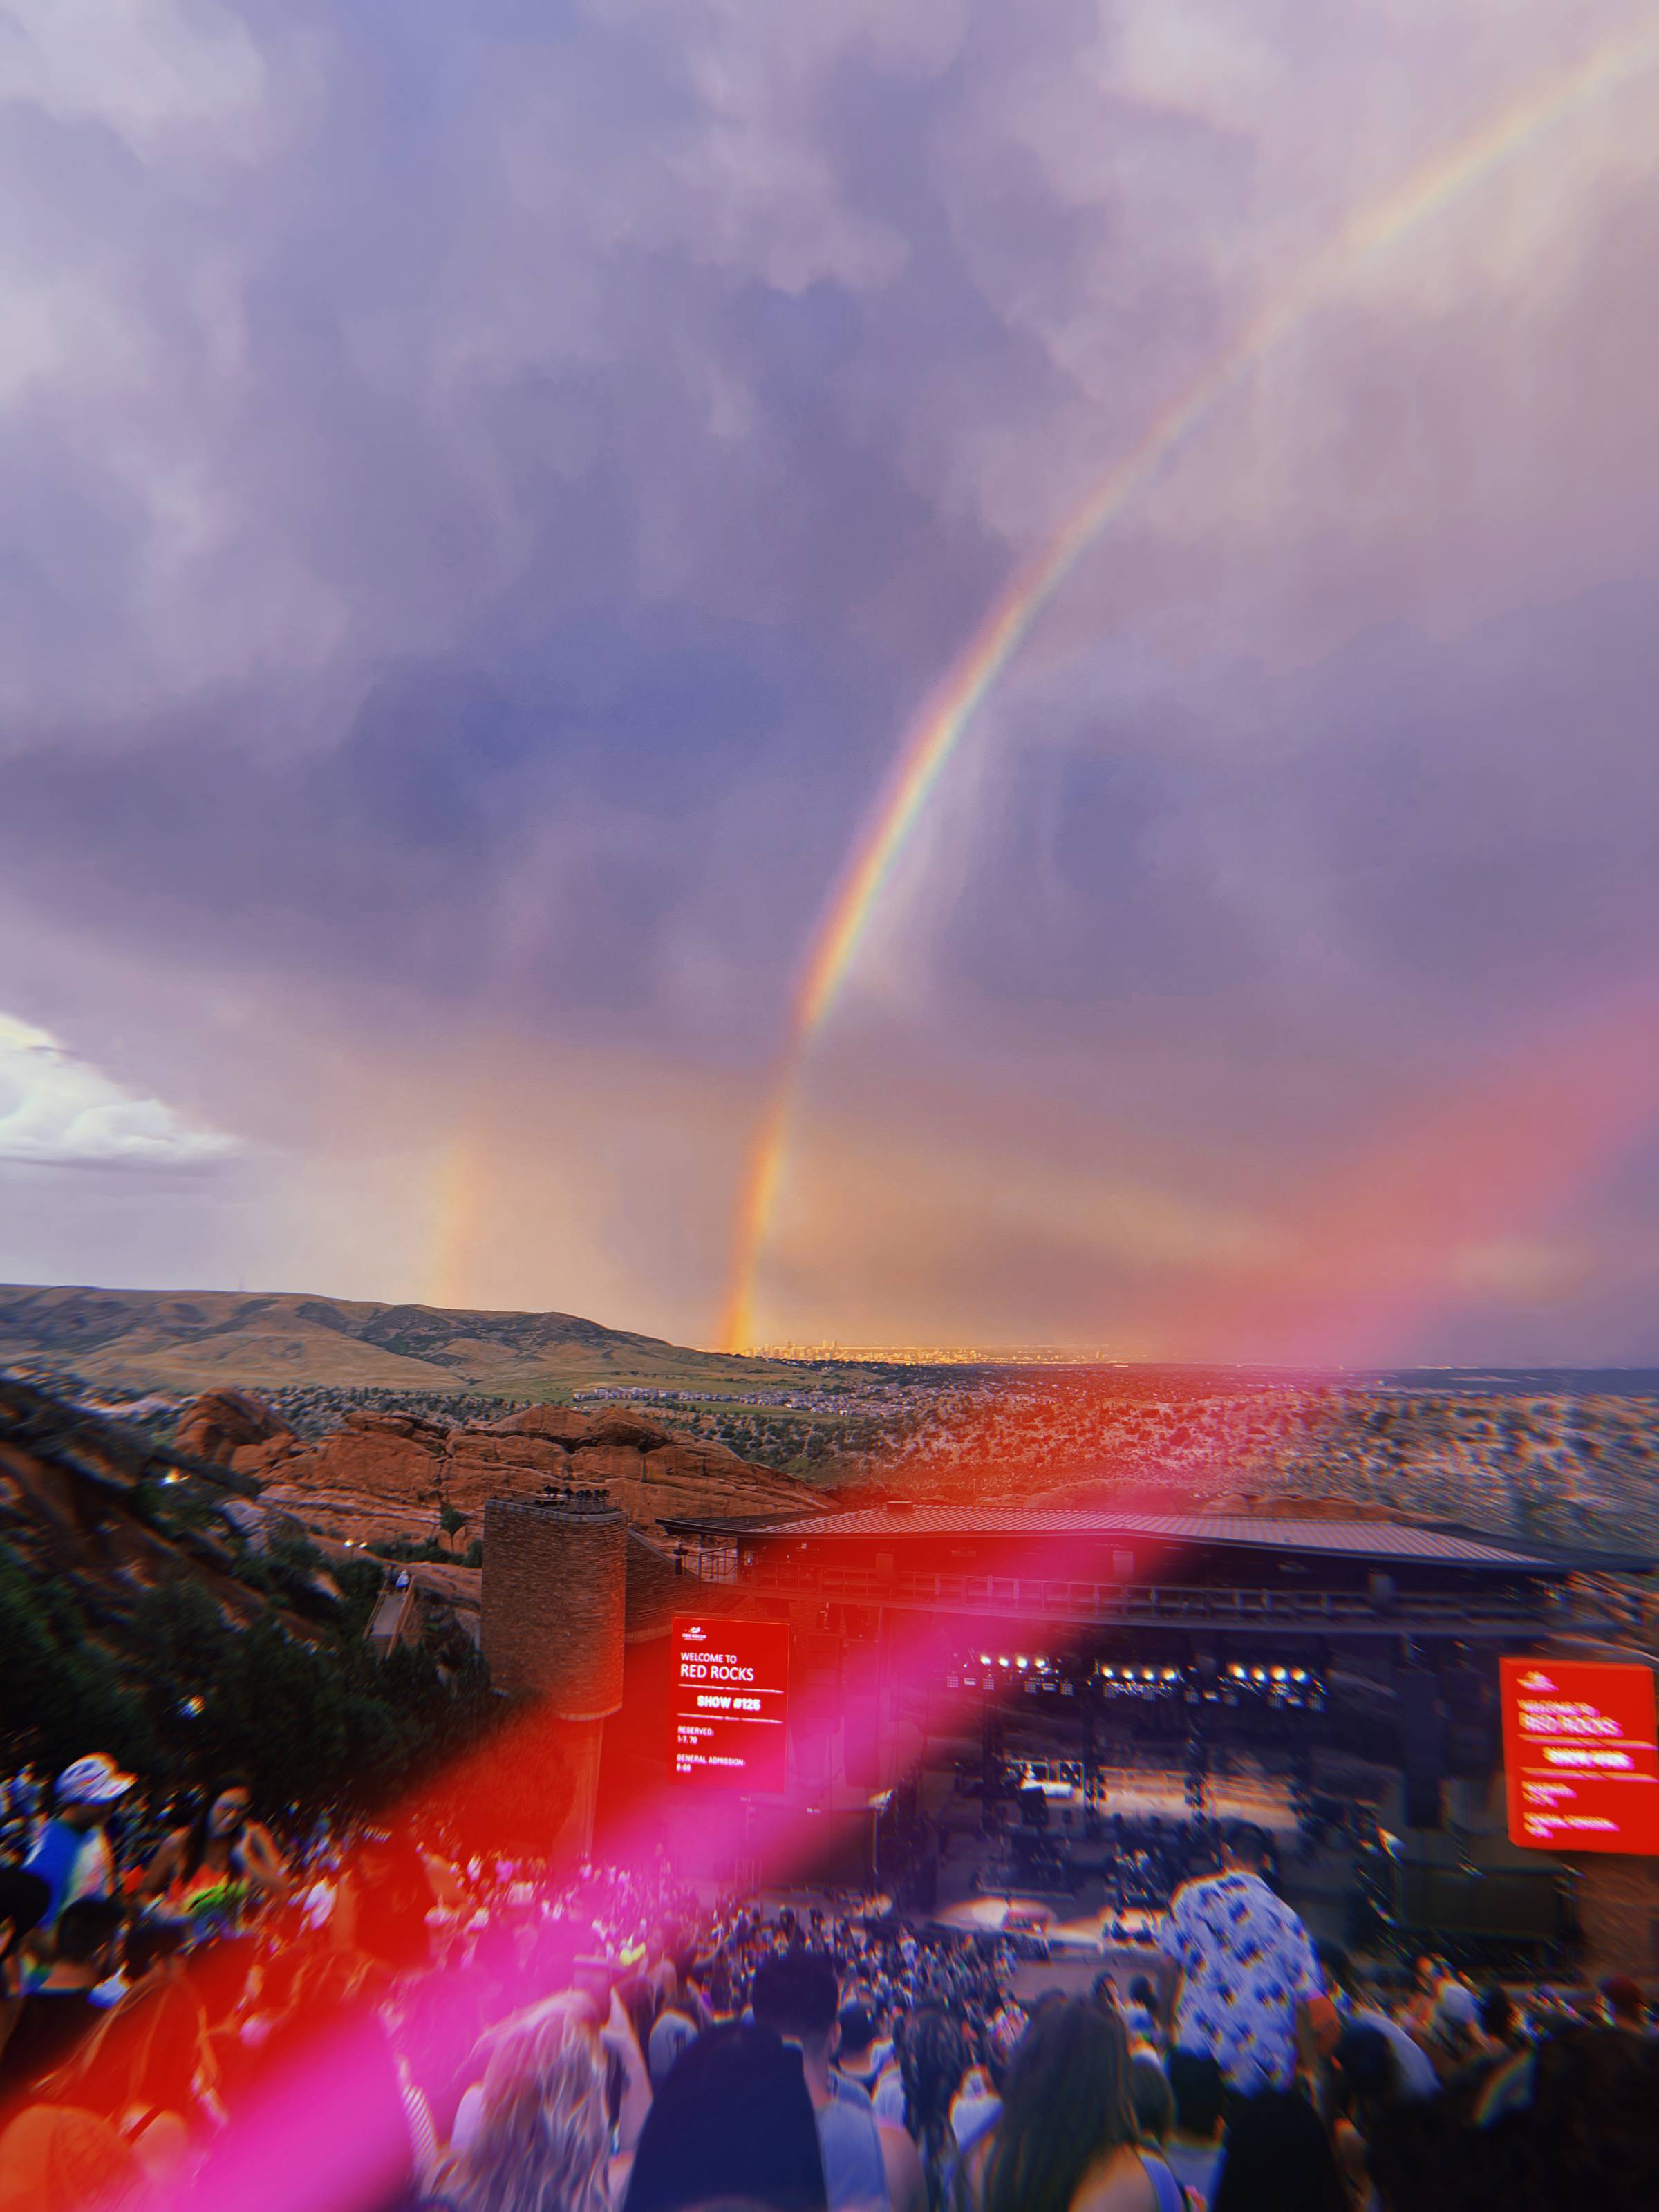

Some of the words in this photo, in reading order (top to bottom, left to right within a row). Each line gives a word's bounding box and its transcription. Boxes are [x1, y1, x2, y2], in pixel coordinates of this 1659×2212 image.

[680, 1652, 724, 1663] WELCOME
[725, 1654, 737, 1664] TO
[680, 1663, 707, 1678] RED
[710, 1665, 754, 1681] ROCKS
[697, 1695, 731, 1709] SHOW
[733, 1698, 761, 1711] #125
[677, 1753, 706, 1763] GENERAL
